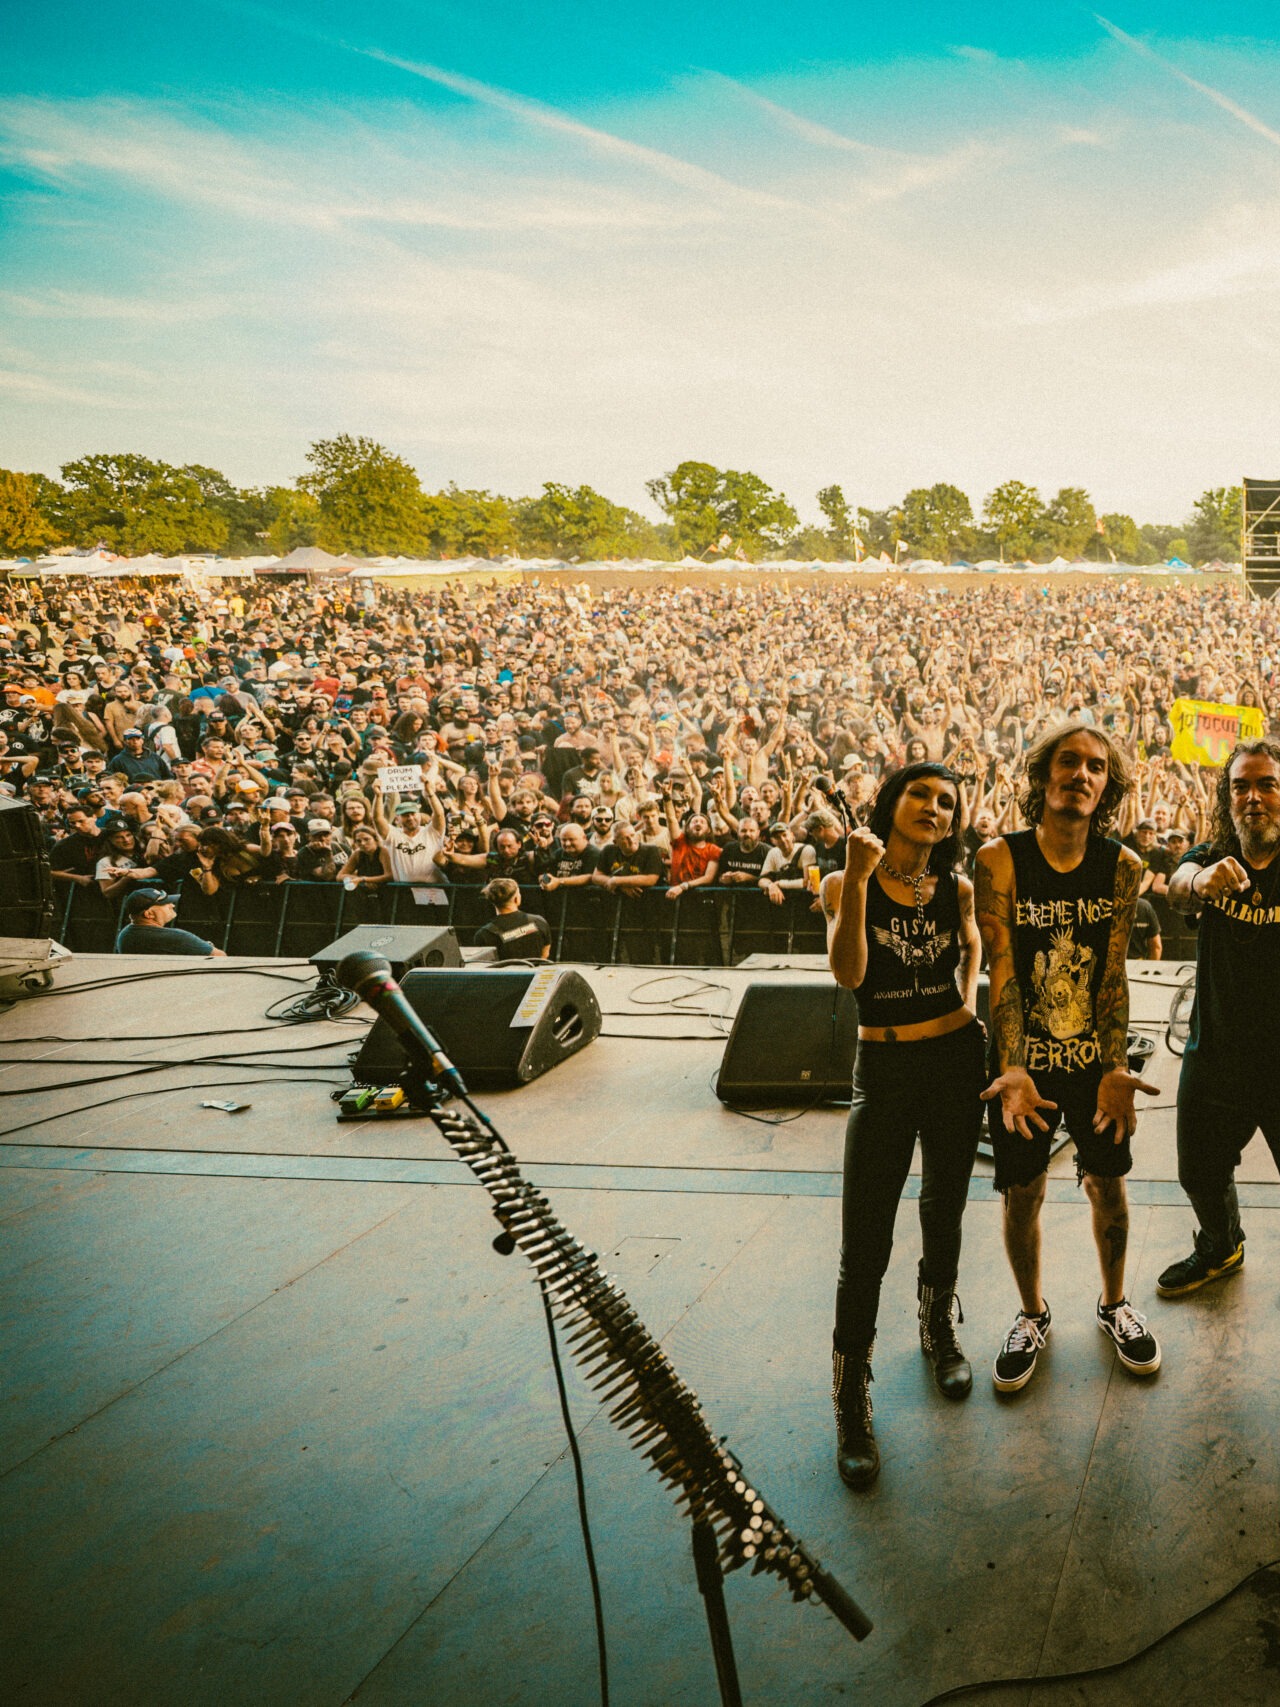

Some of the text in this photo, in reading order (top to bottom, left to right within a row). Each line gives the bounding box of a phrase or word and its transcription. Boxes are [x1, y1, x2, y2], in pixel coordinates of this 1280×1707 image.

[387, 767, 413, 775] DRUM
[386, 783, 419, 791] PLEASE
[890, 917, 936, 938] GISM
[873, 989, 913, 1000] ANARCHY
